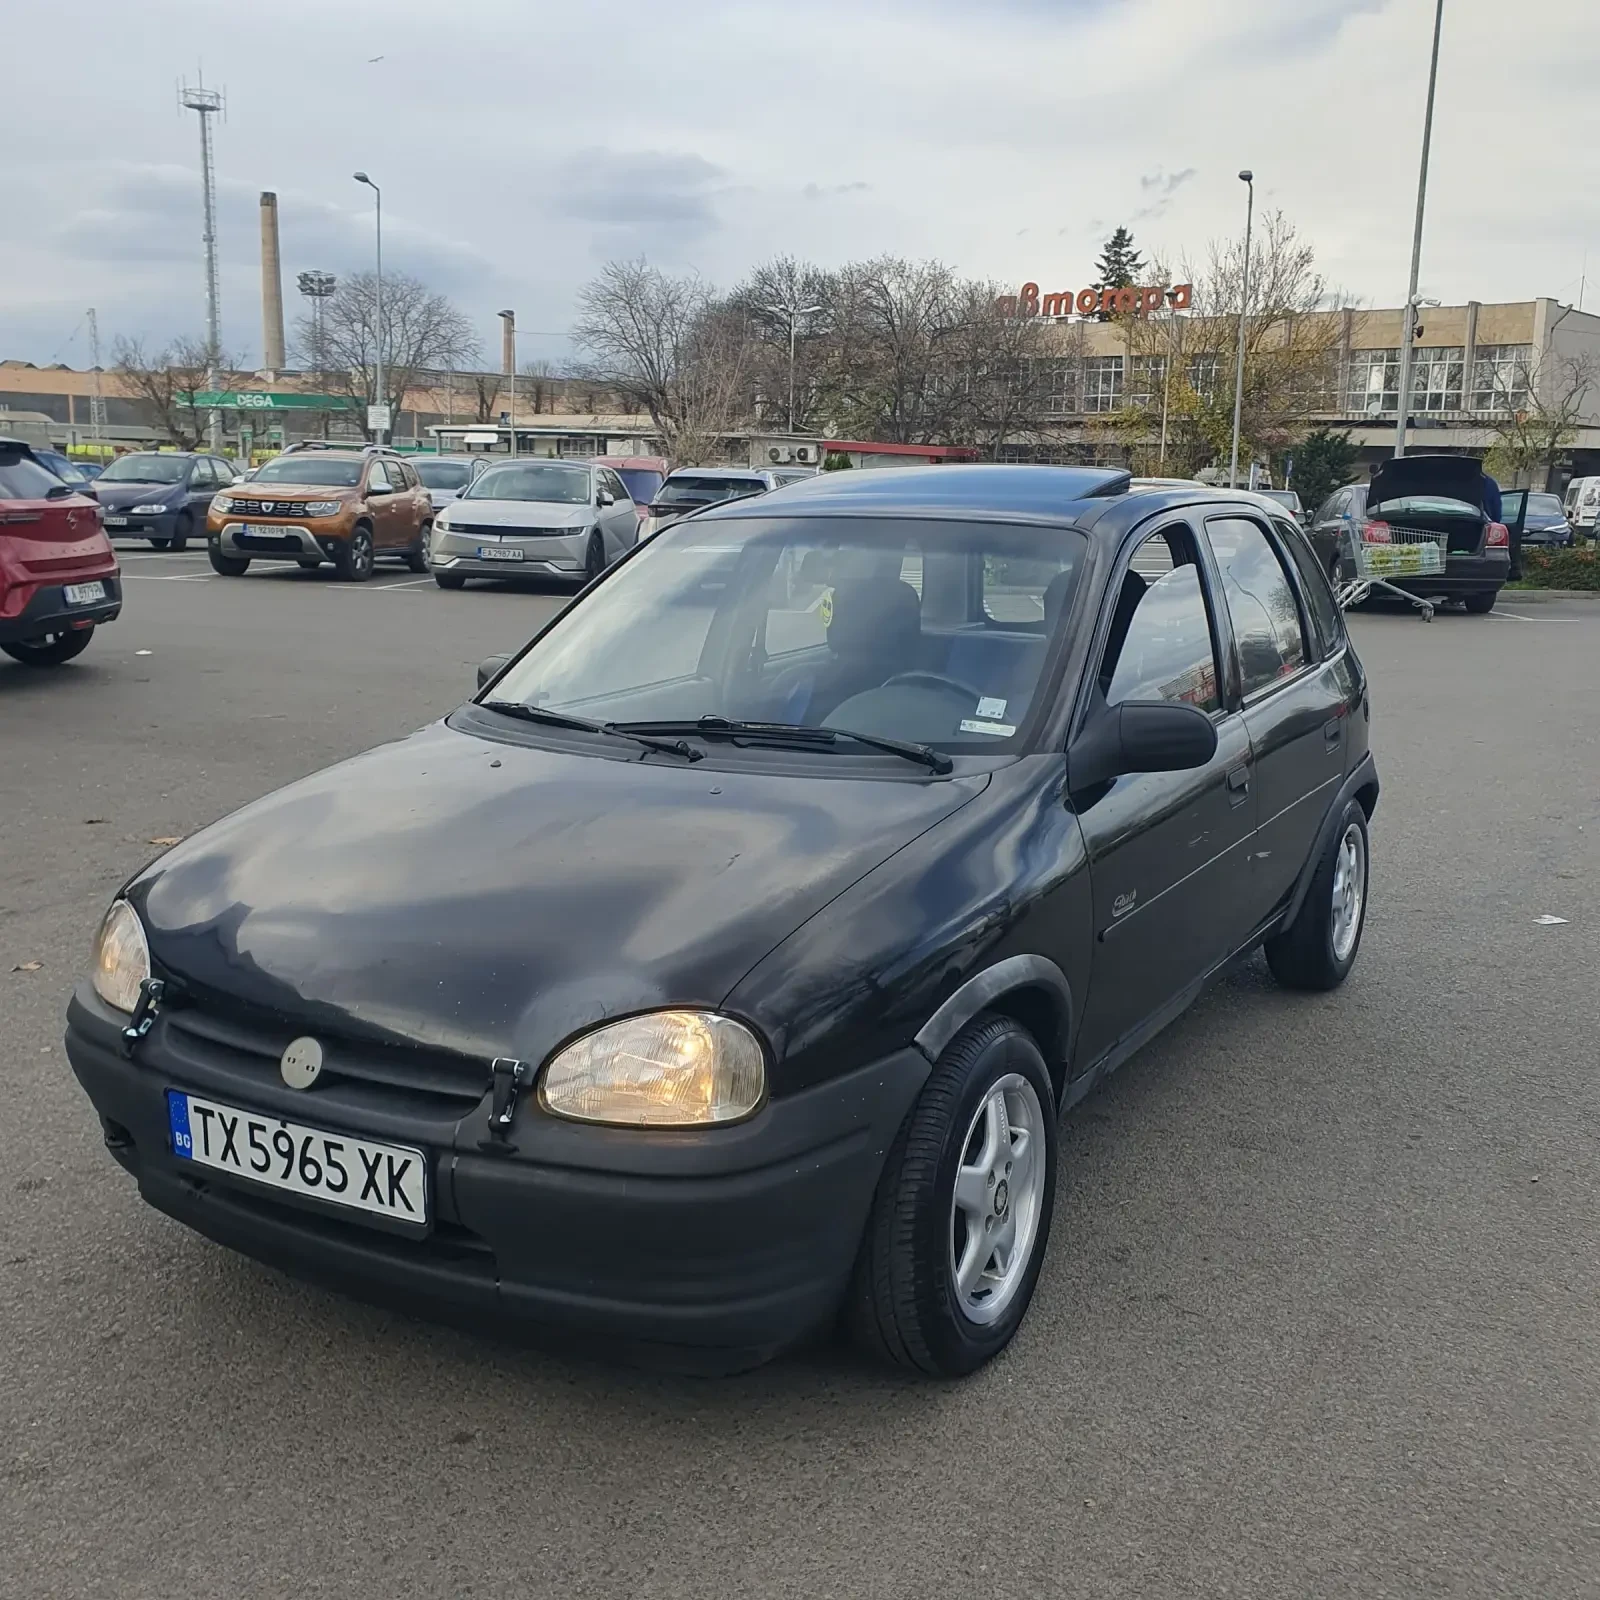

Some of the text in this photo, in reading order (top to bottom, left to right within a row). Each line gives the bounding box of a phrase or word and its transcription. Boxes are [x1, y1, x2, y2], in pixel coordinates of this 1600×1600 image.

[493, 549, 511, 557] 2987
[175, 1131, 191, 1149] BG
[193, 1105, 415, 1212] TX 5965 XK
